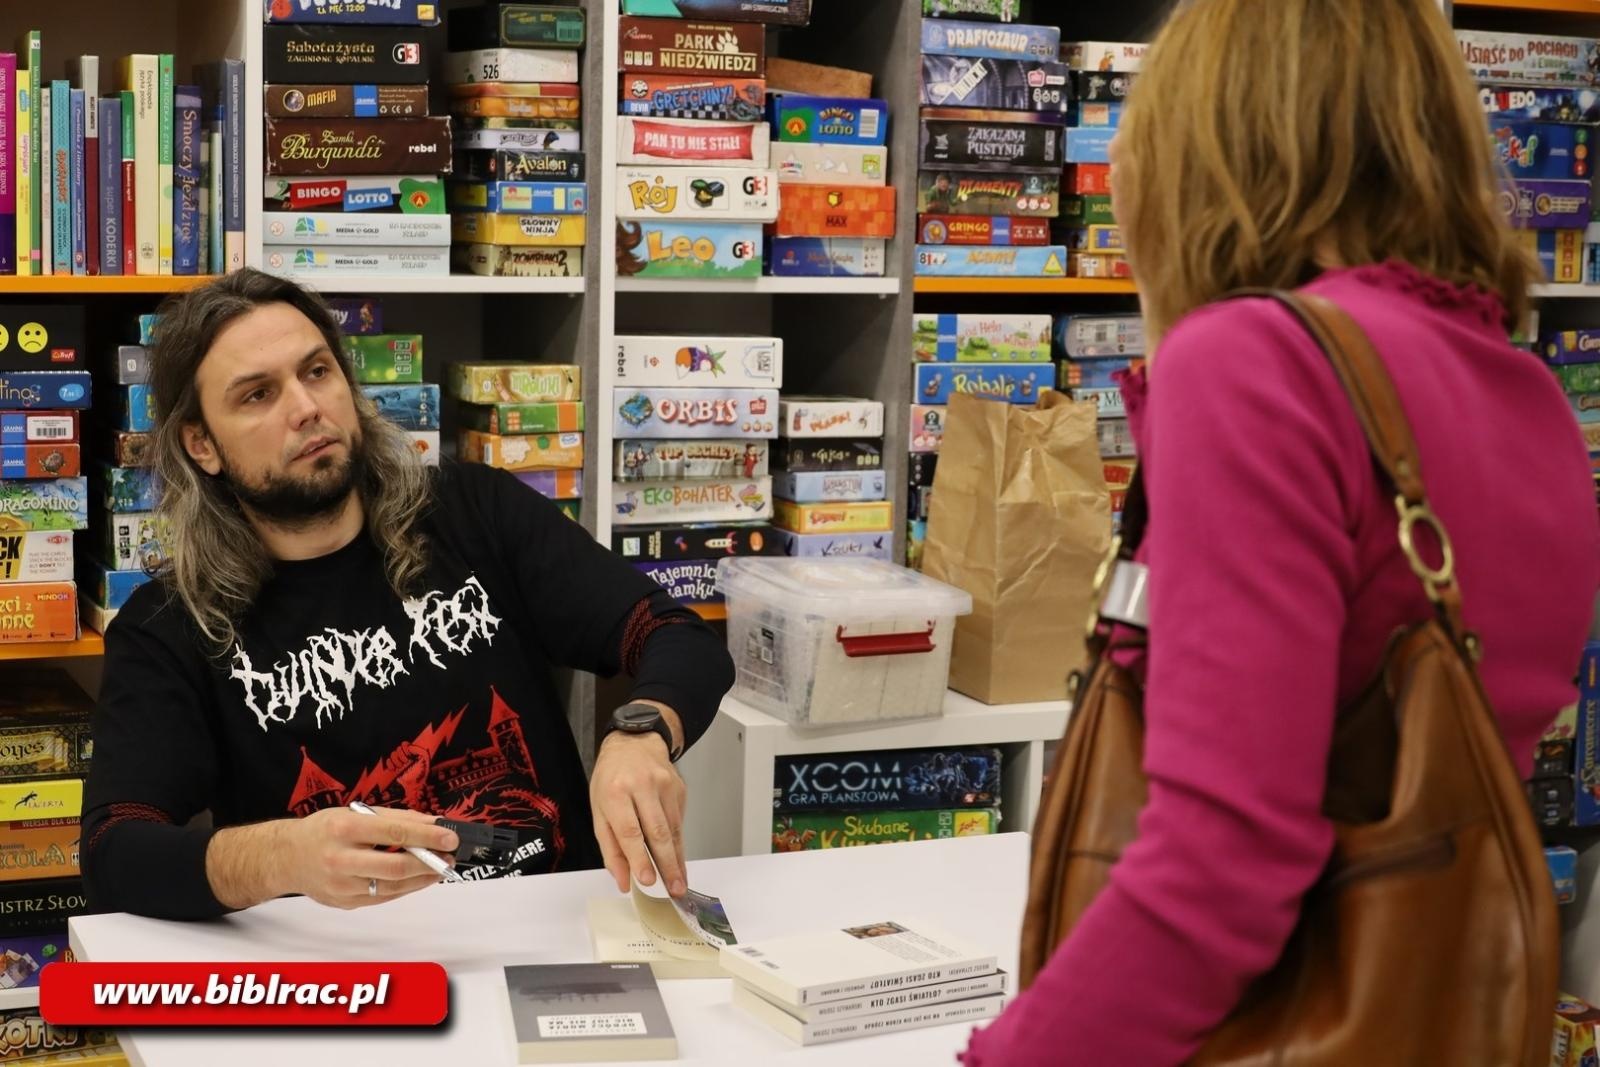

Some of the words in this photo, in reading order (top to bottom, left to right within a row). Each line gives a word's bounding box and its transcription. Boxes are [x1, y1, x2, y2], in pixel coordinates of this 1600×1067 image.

[287, 41, 375, 57] Sabotażysta
[675, 33, 715, 51] PARK
[659, 50, 757, 71] NIEDŹWIEDZI
[1509, 47, 1524, 62] DO
[483, 64, 499, 80] 526
[307, 89, 337, 107] MAFIA
[180, 110, 197, 174] Smoczy
[644, 131, 668, 149] PAN
[669, 134, 686, 150] TU
[687, 135, 707, 151] NIE
[968, 127, 1026, 144] ZAKAZANA
[281, 134, 384, 168] Burgundii
[408, 143, 437, 153] rebel
[967, 143, 1025, 160] PUSTYNIA
[516, 153, 567, 175] Avalon
[107, 186, 117, 213] super
[296, 186, 341, 200] BINGO
[348, 193, 389, 205] LOTTO
[630, 176, 679, 214] Rój
[521, 218, 560, 227] SŁOWNY
[526, 226, 556, 234] NINJA
[825, 215, 848, 228] MAX
[949, 223, 990, 233] GRINGO
[106, 217, 117, 268] KODERKI
[646, 231, 716, 262] Leo
[617, 345, 626, 377] rebel
[657, 398, 739, 426] ORBIS
[646, 564, 719, 586] Tajemnic
[0, 614, 34, 630] nne
[789, 761, 902, 793] XCOM
[789, 794, 817, 805] GRA
[821, 791, 900, 804] PLANSZOWA
[51, 818, 64, 826] DLA
[66, 816, 81, 825] GRA
[843, 815, 910, 836] Skubane
[905, 973, 926, 984] ZGASI
[928, 971, 941, 981] KTO
[870, 998, 884, 1009] KTO
[886, 995, 907, 1006] ZGASI
[908, 989, 942, 1003] ŚWIATŁO?
